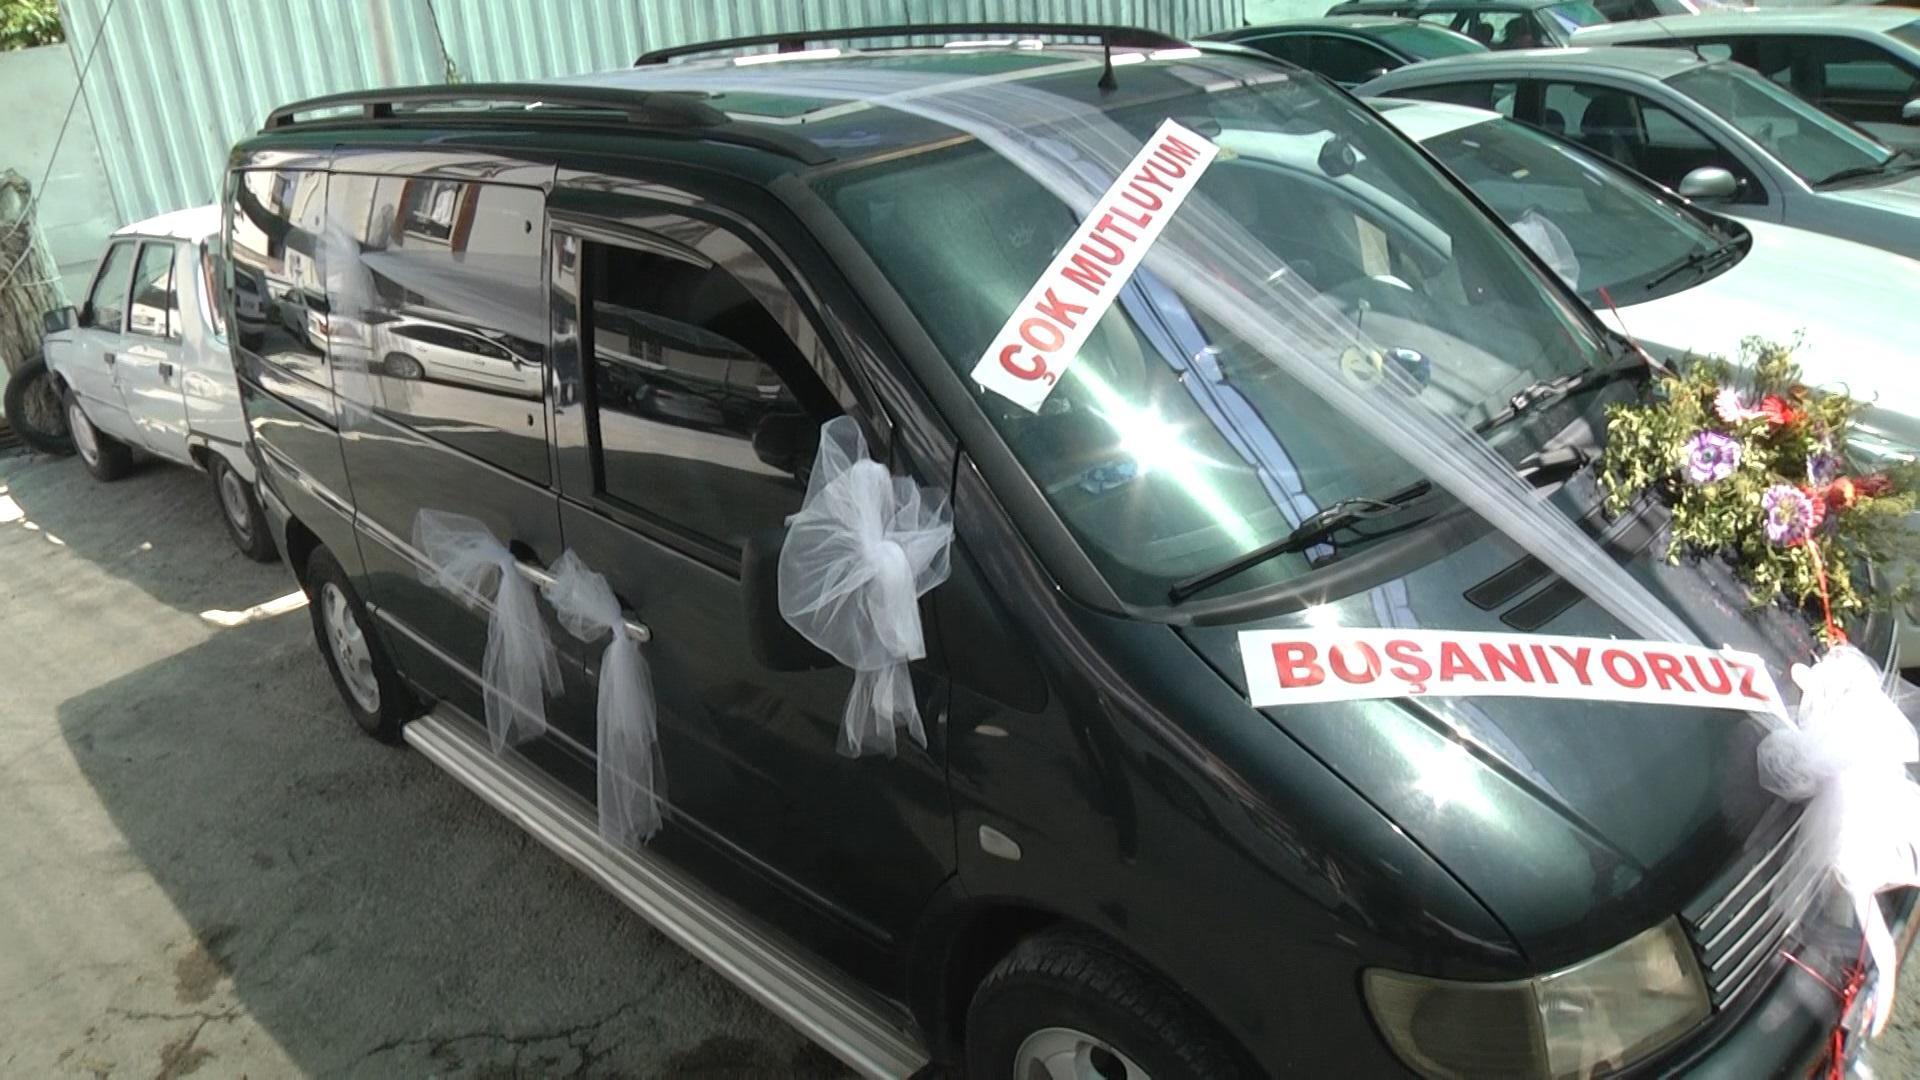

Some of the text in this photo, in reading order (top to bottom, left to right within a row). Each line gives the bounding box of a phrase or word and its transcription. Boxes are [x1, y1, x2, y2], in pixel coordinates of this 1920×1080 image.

[1000, 135, 1201, 386] ÇOK MUTLUYUM
[1271, 641, 1770, 702] BOŞANIYORUZ
